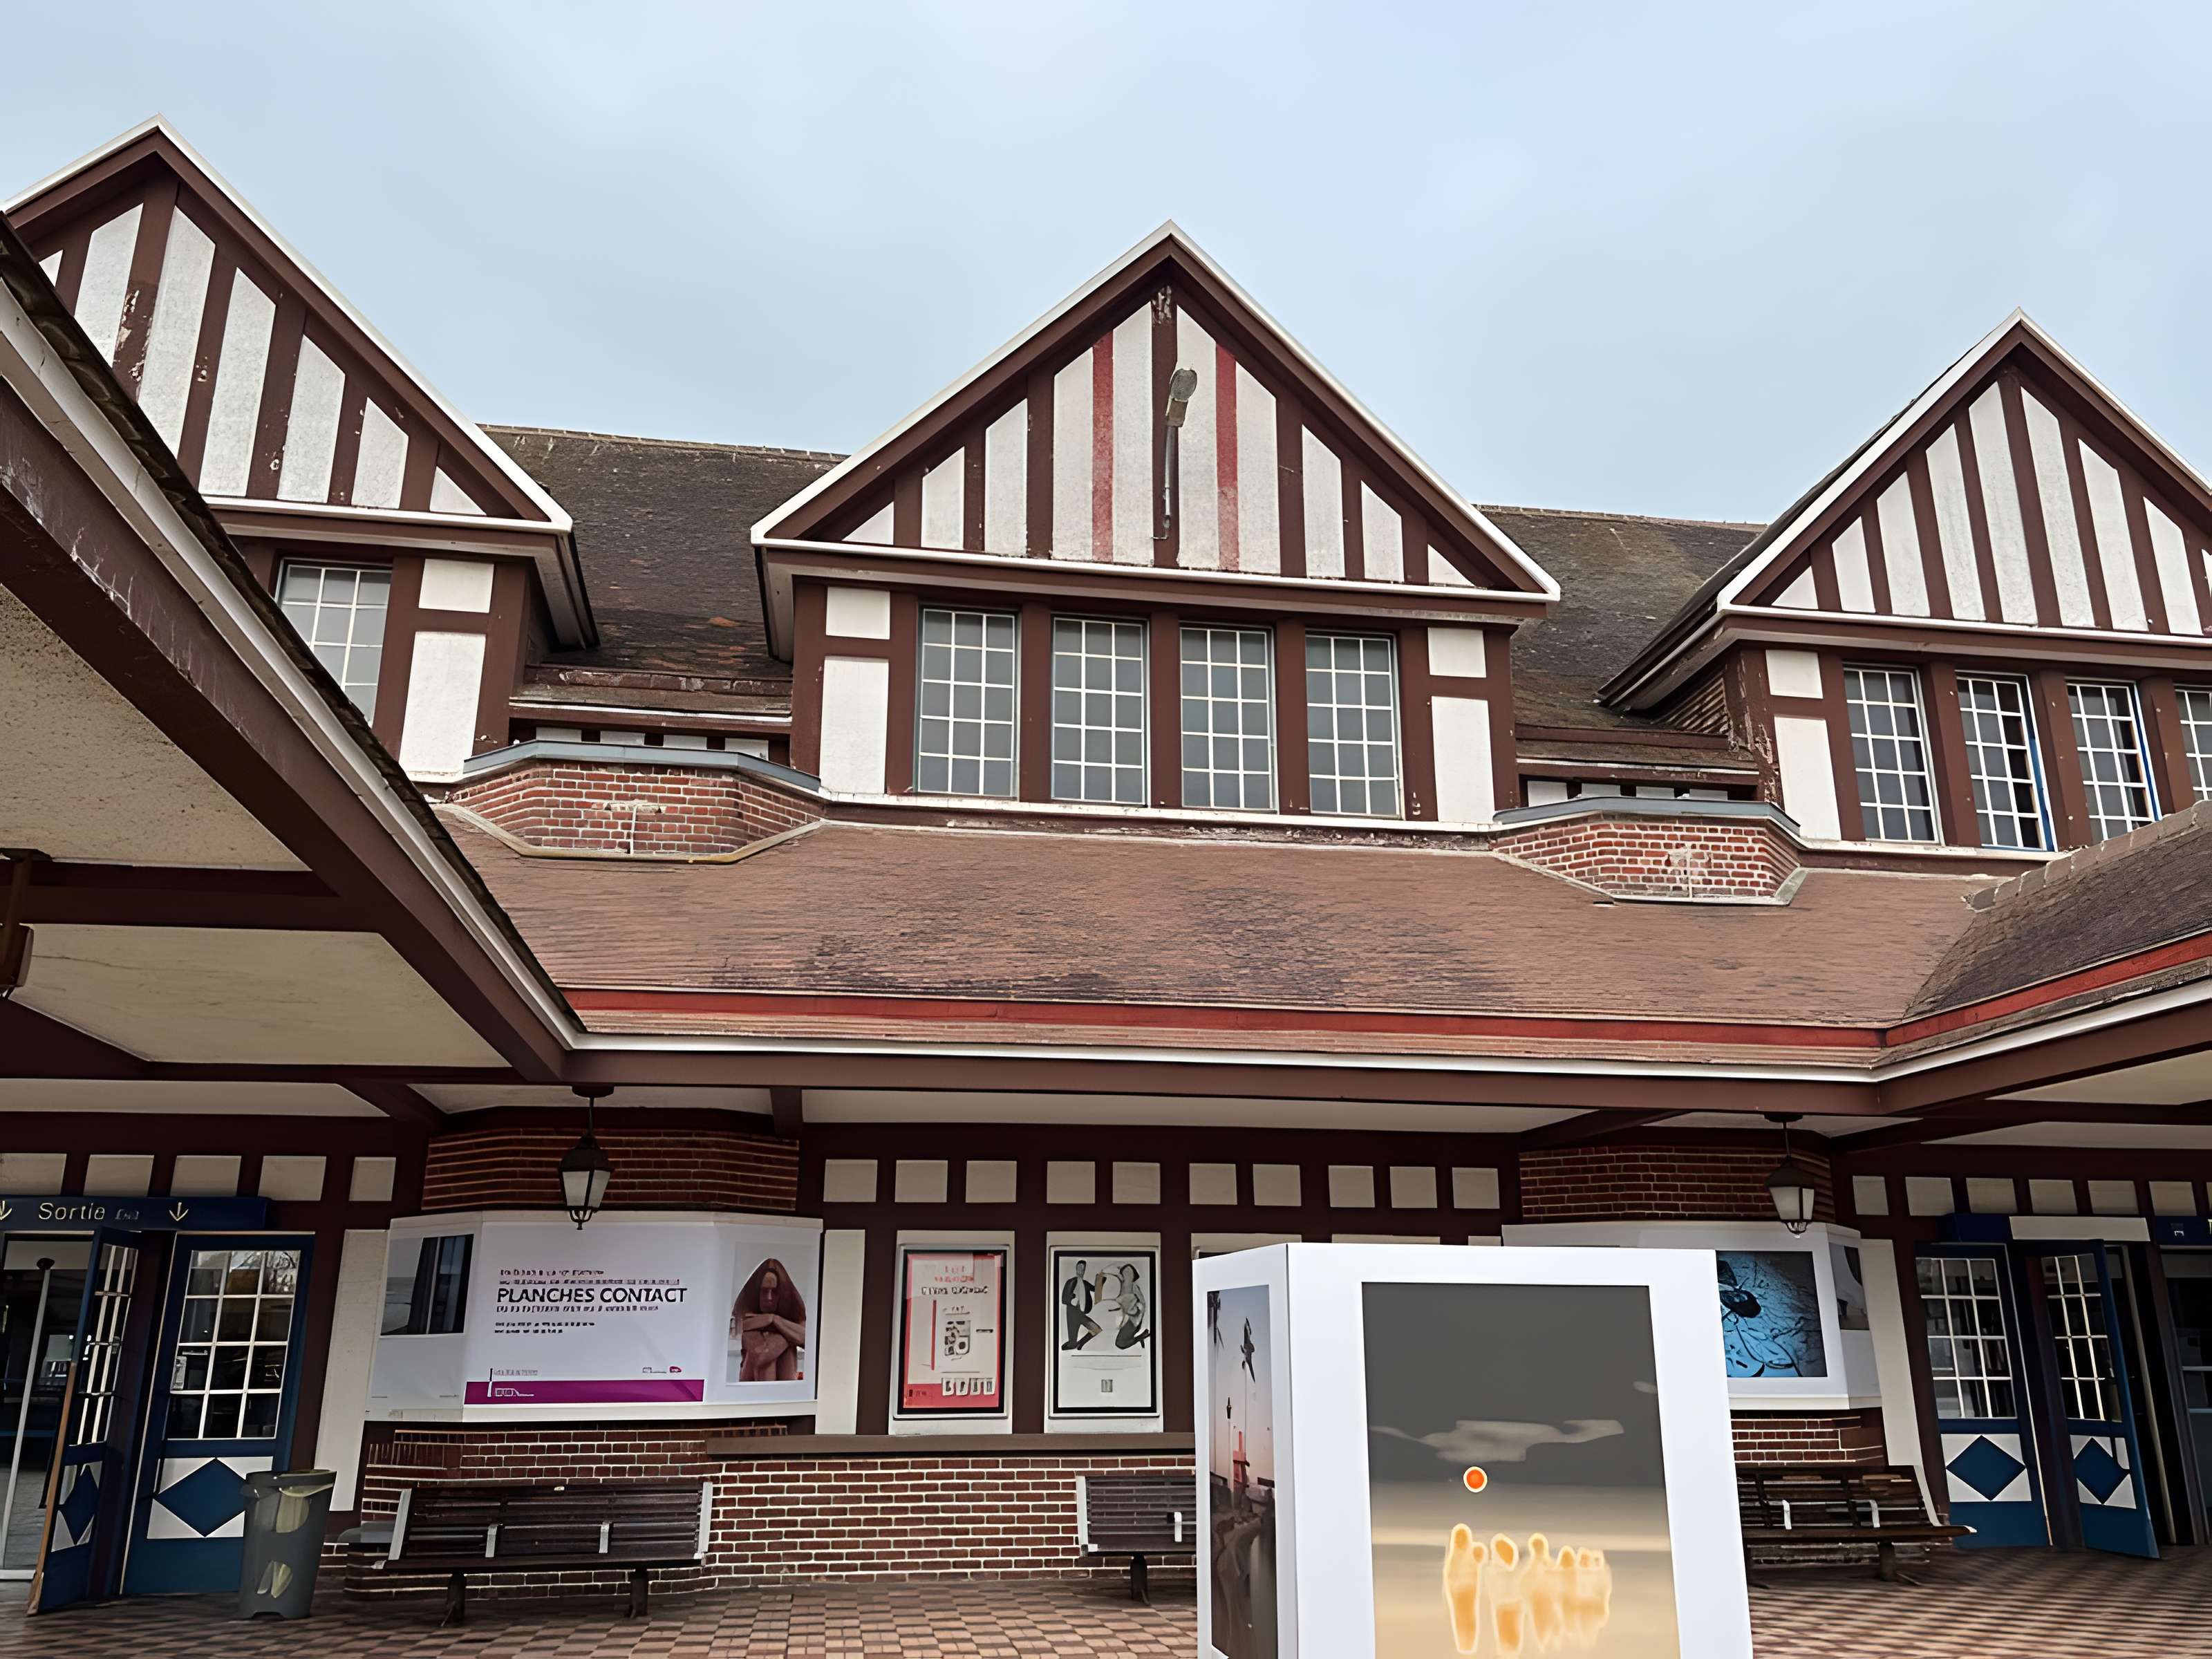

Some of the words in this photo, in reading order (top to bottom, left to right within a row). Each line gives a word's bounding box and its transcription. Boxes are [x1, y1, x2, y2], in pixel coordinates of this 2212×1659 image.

[38, 1202, 105, 1220] Sortie
[497, 1287, 594, 1303] PLANCHES
[599, 1287, 688, 1303] CONTACT
